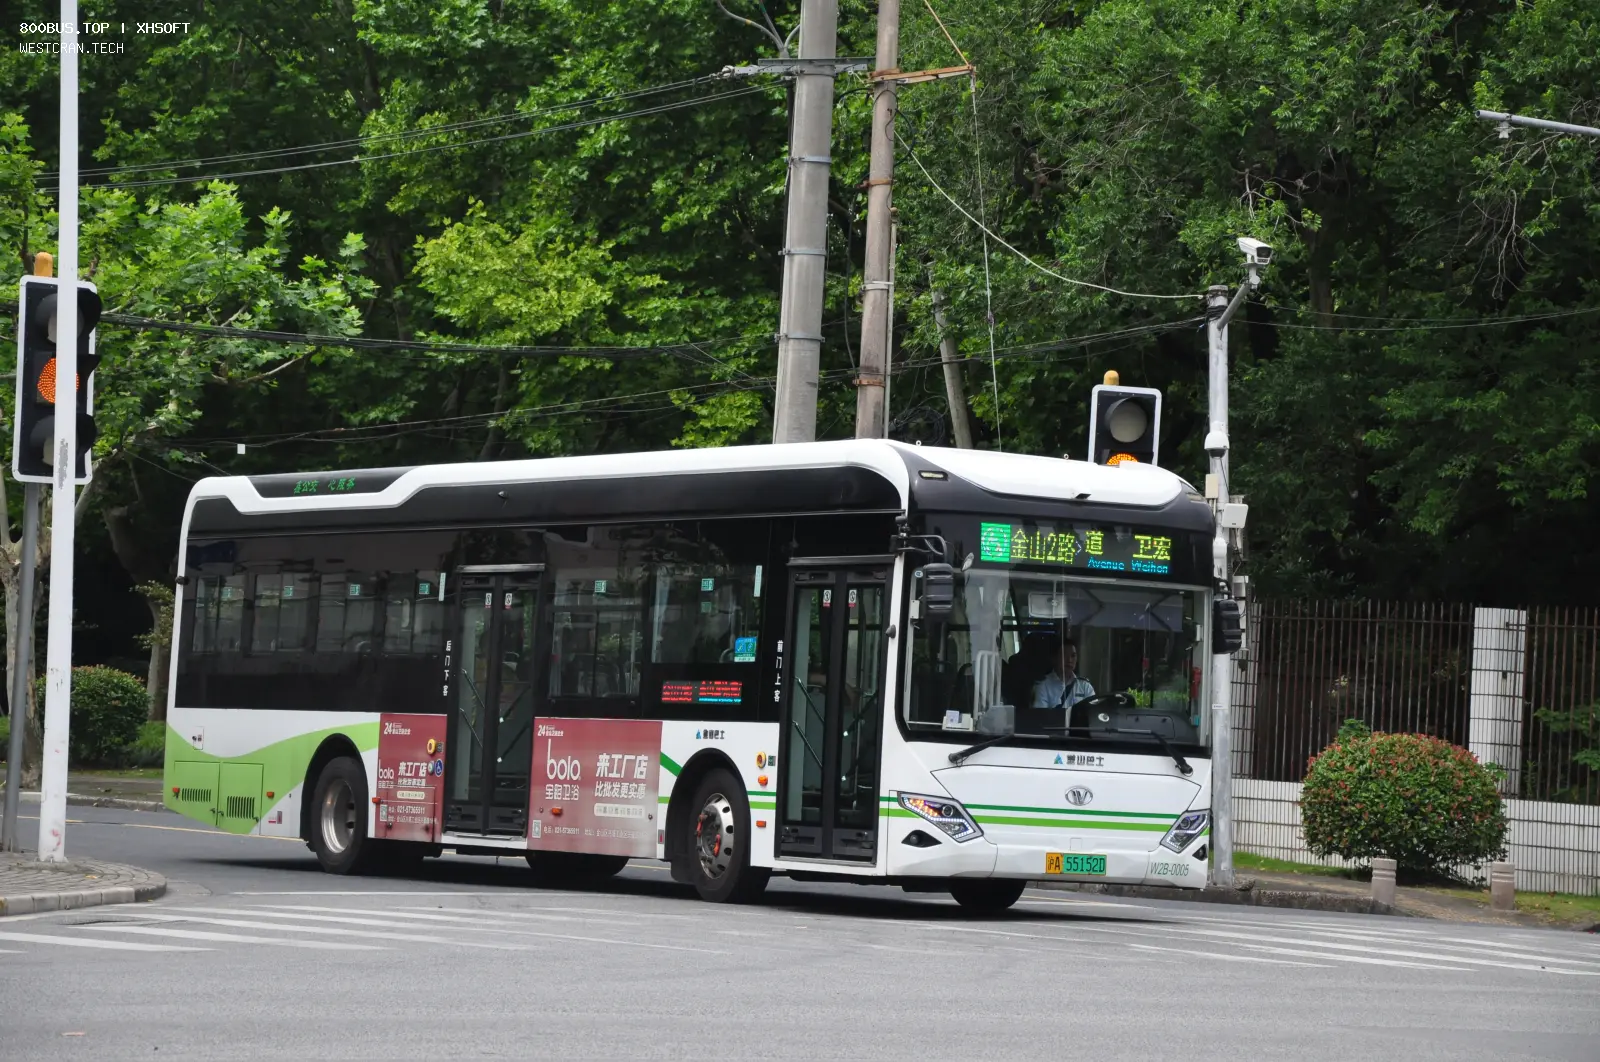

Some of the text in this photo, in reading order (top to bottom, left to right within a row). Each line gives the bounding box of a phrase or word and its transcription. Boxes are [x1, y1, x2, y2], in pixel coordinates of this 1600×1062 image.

[1011, 528, 1172, 564] 金山2路 道 卫宏
[1087, 556, 1125, 570] Avenue
[537, 725, 546, 737] 24
[546, 738, 581, 781] bolo
[595, 752, 649, 780] 来工厂店
[378, 758, 395, 780] bolo
[398, 761, 428, 777] 来工厂店
[594, 780, 647, 799] 比批发更实惠
[1066, 855, 1106, 873] 55152D
[1150, 862, 1190, 877] W2B-0005
